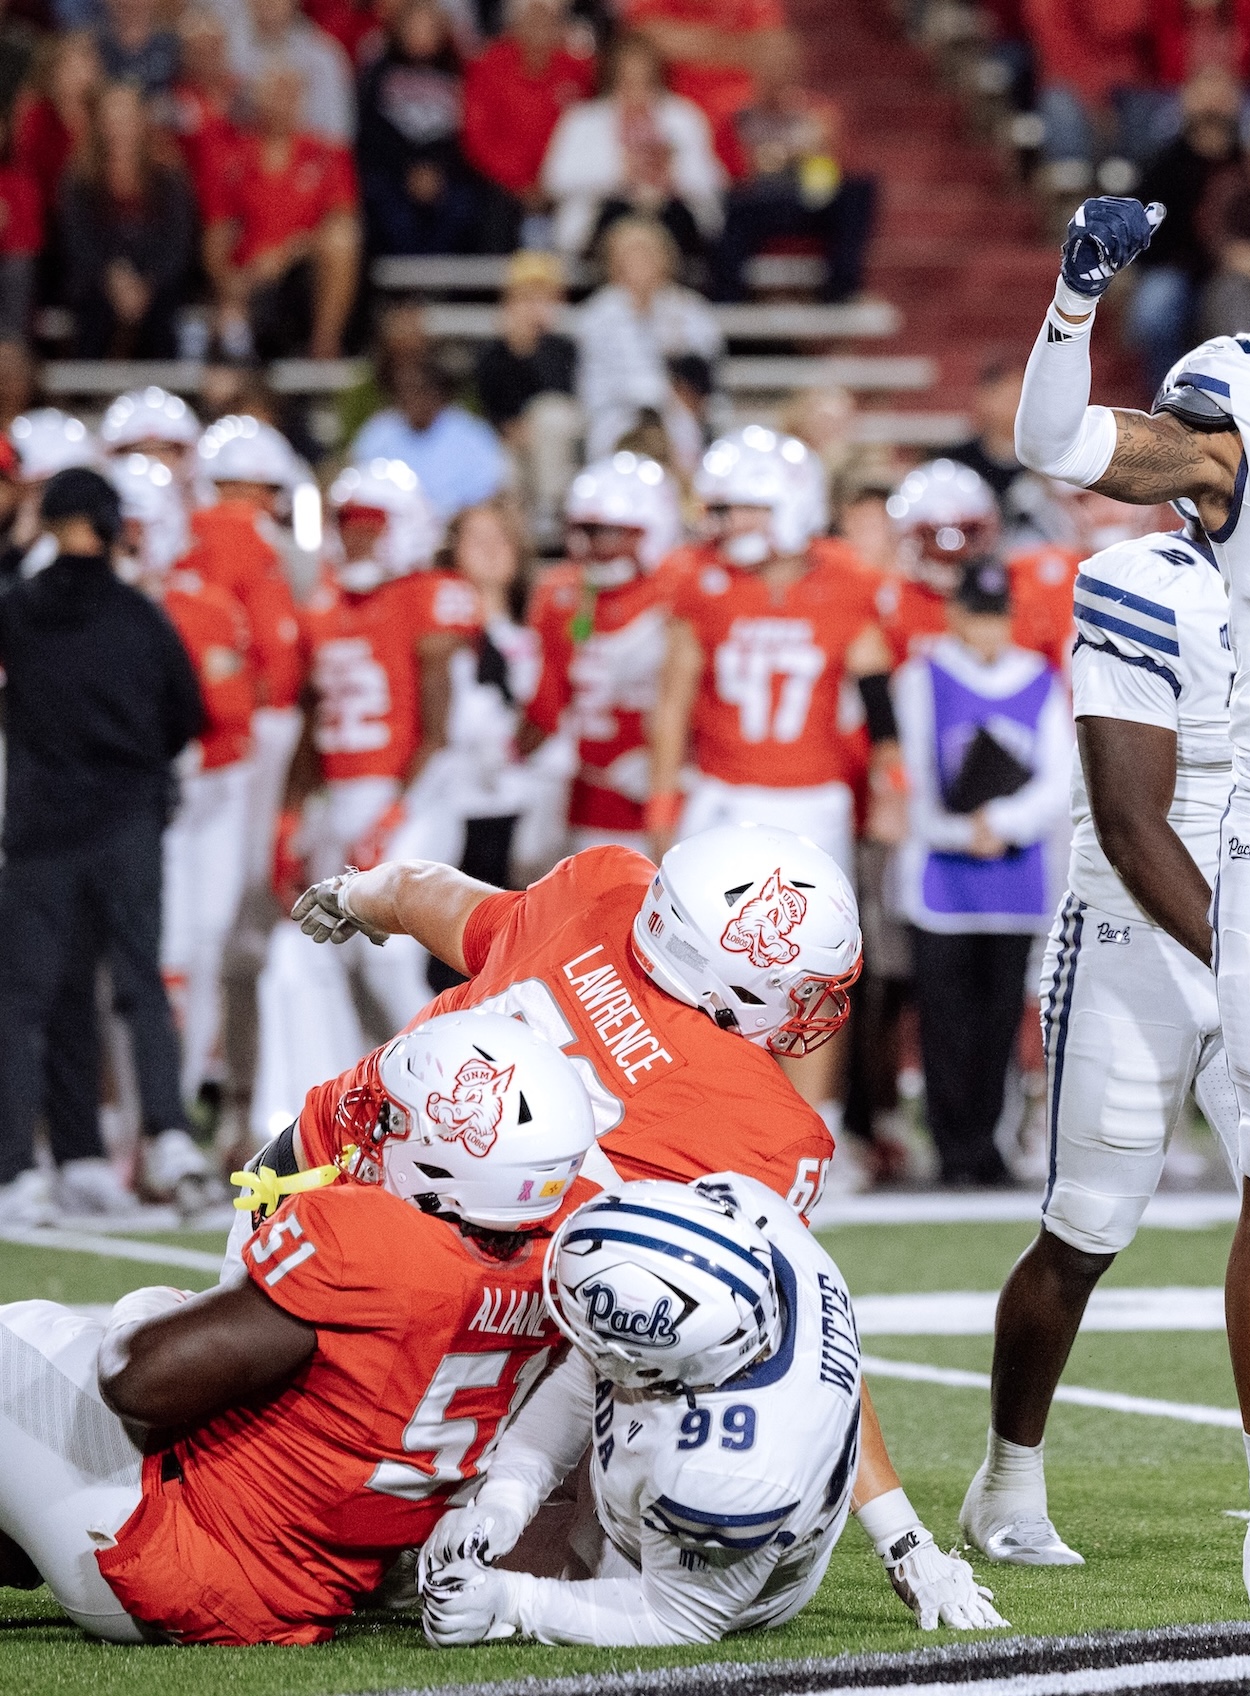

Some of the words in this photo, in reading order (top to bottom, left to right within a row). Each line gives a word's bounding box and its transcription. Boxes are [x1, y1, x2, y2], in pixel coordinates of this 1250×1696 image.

[713, 640, 826, 744] 47
[783, 892, 799, 919] UNM
[726, 932, 749, 948] LOBOS
[561, 943, 673, 1085] LAWRENCE
[461, 1070, 491, 1083] UNM
[467, 1131, 488, 1151] LOBOS
[250, 1211, 318, 1288] 51
[582, 1280, 681, 1348] Pack
[817, 1272, 859, 1397] WITTE
[675, 1402, 759, 1451] 99
[889, 1530, 920, 1561] NIKE
